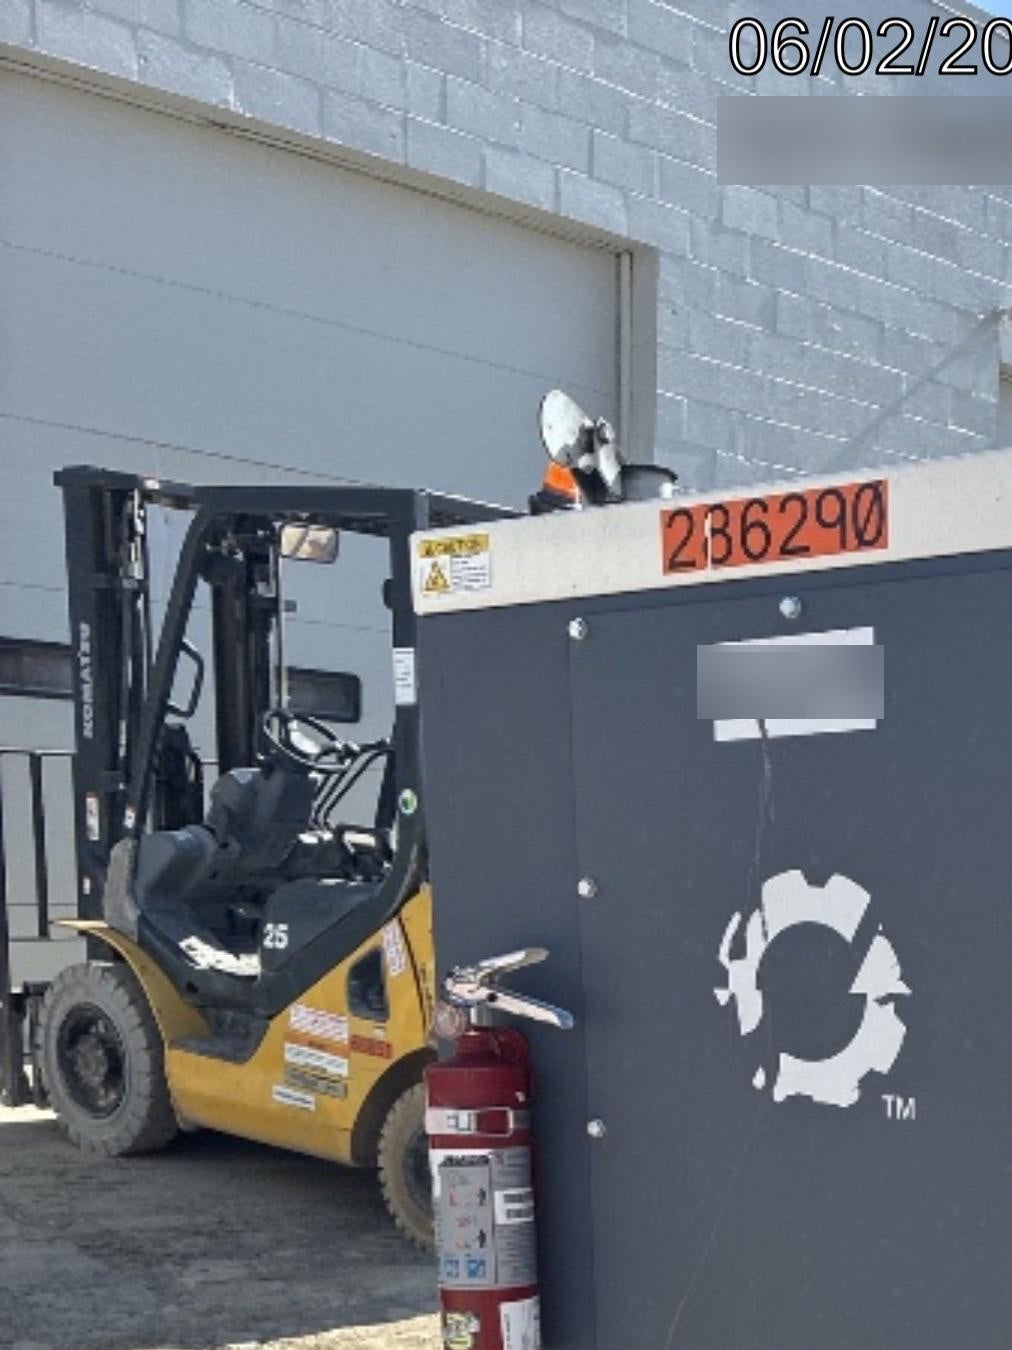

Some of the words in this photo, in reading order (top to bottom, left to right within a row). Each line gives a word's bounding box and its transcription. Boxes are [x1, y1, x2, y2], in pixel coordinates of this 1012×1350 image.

[666, 482, 884, 570] 286290
[79, 622, 93, 738] KOMATSU
[263, 922, 289, 949] 25
[881, 1094, 916, 1120] TM
